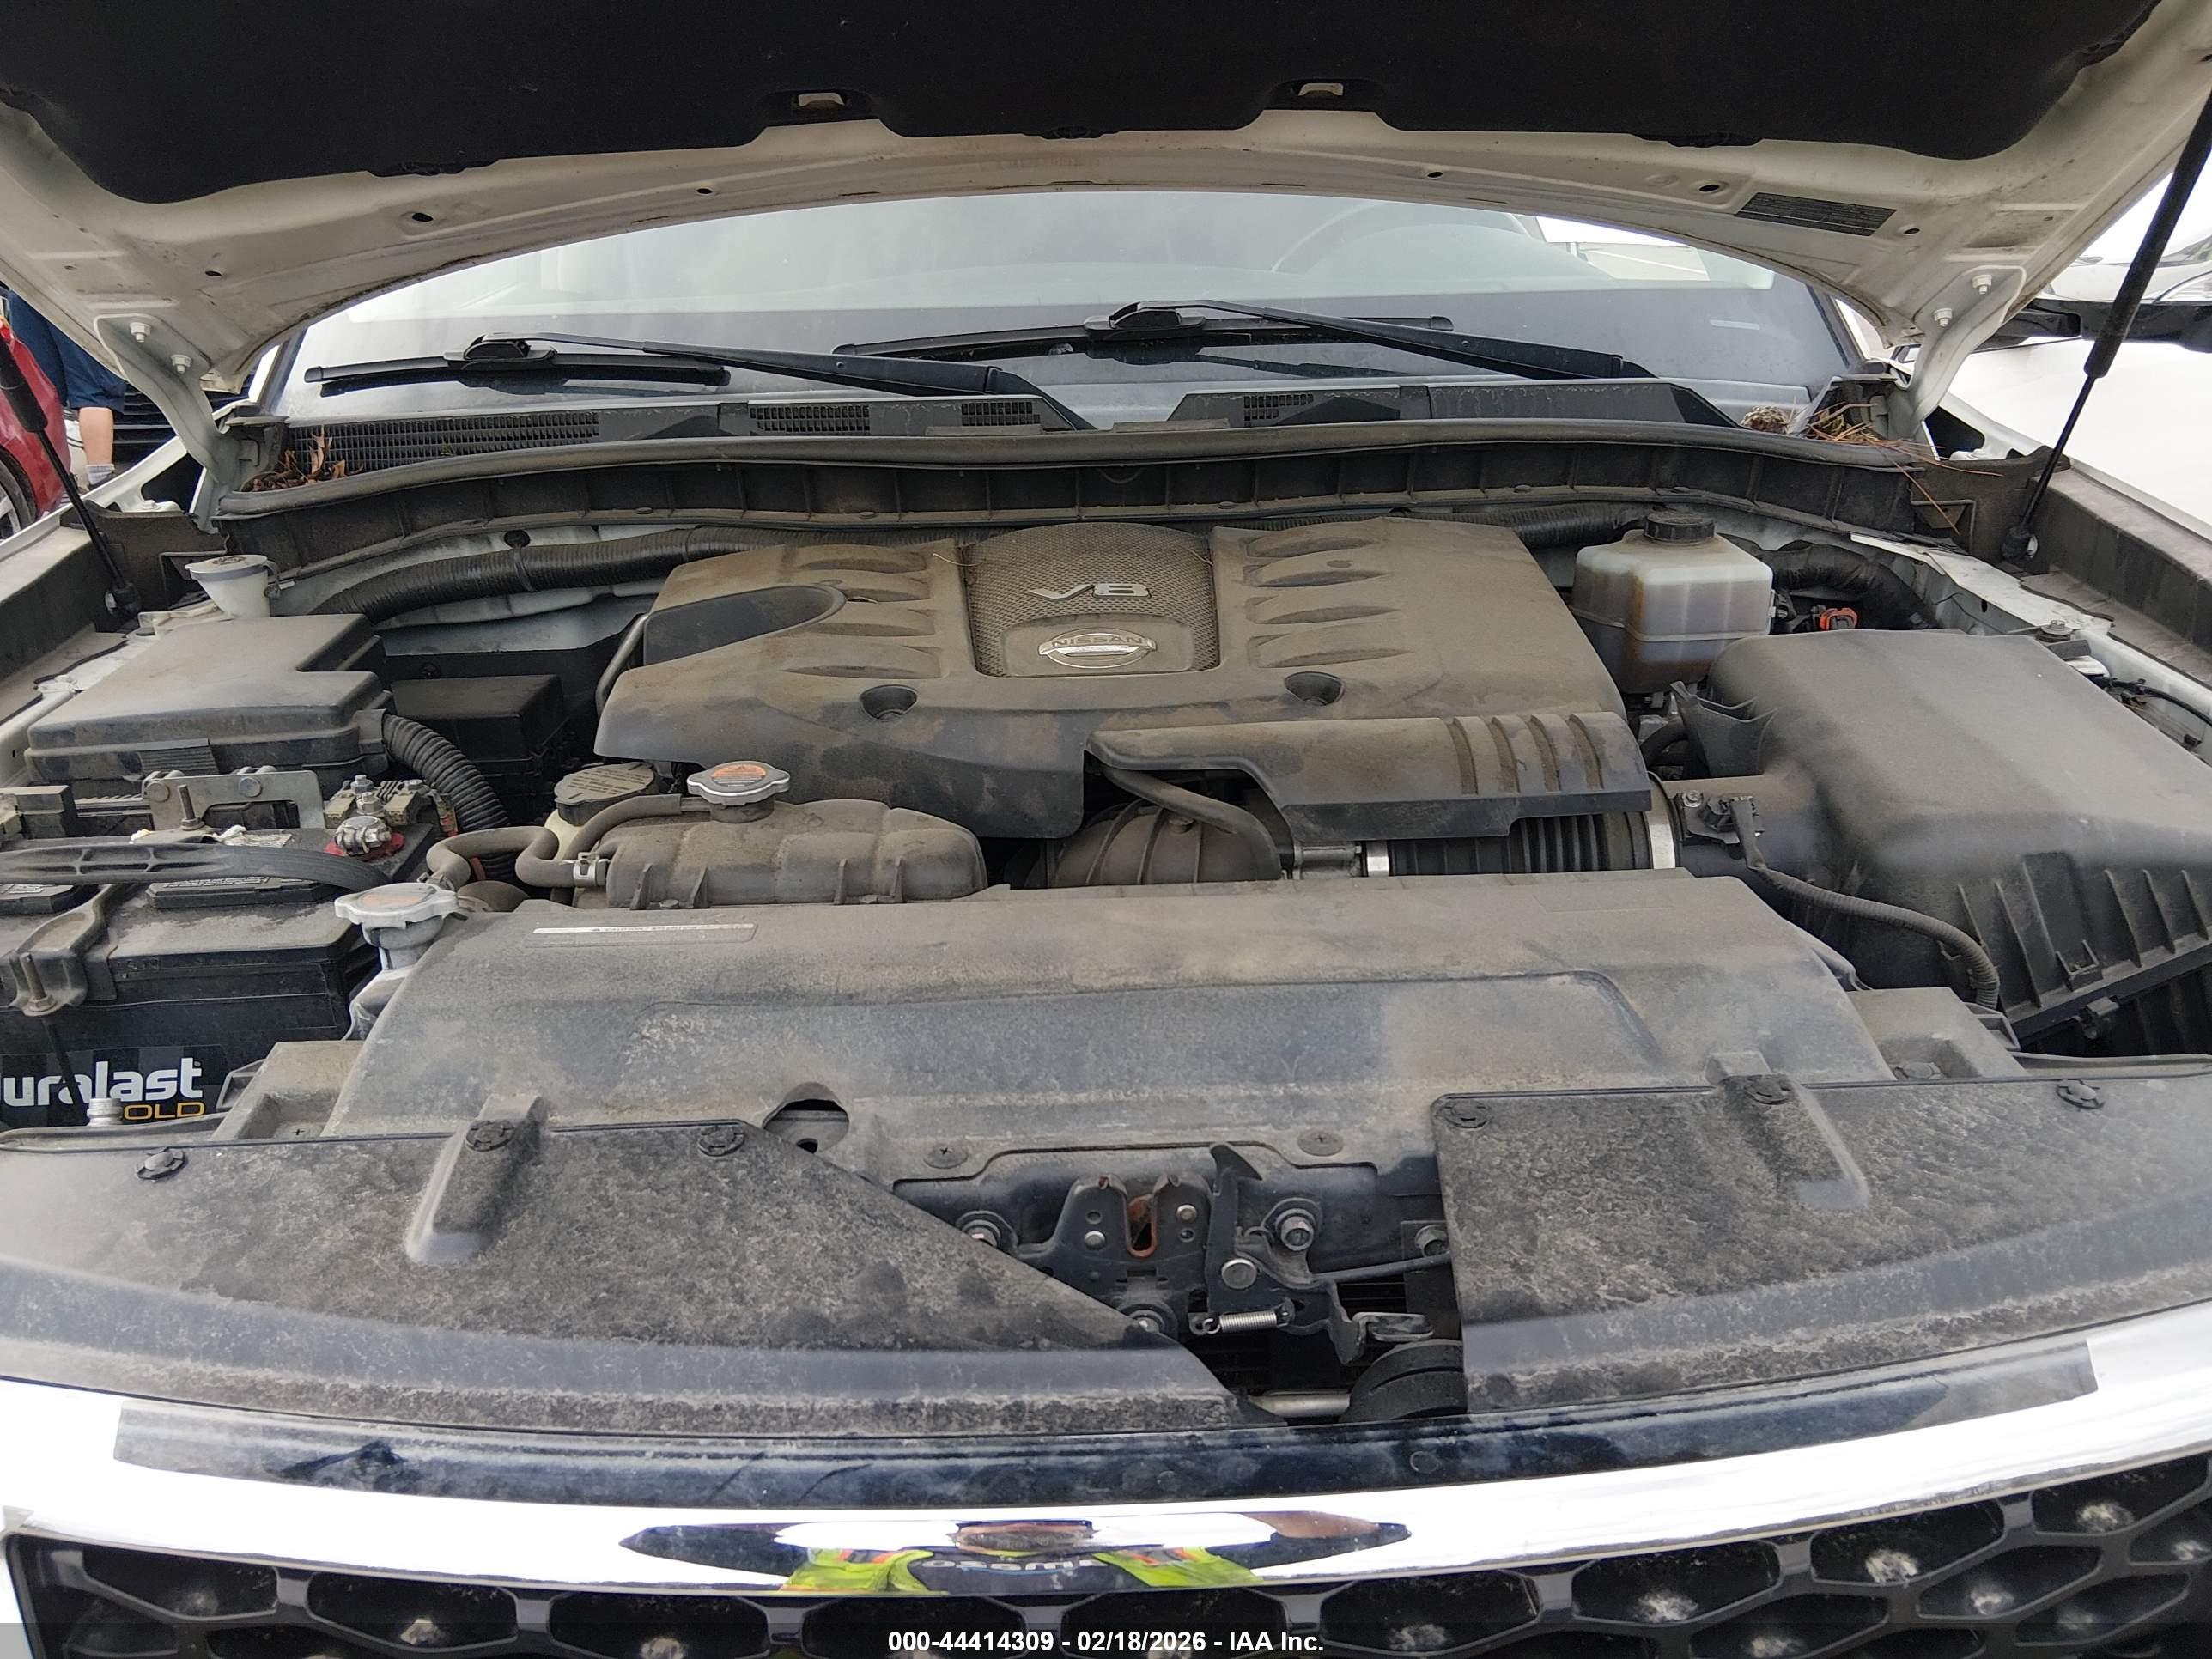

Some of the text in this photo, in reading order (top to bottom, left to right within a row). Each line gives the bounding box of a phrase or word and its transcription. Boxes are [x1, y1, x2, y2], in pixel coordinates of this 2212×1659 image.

[1029, 583, 1152, 601] V8
[1051, 635, 1143, 647] NISSAN
[0, 1057, 204, 1108] uralast
[123, 1101, 206, 1121] OLD
